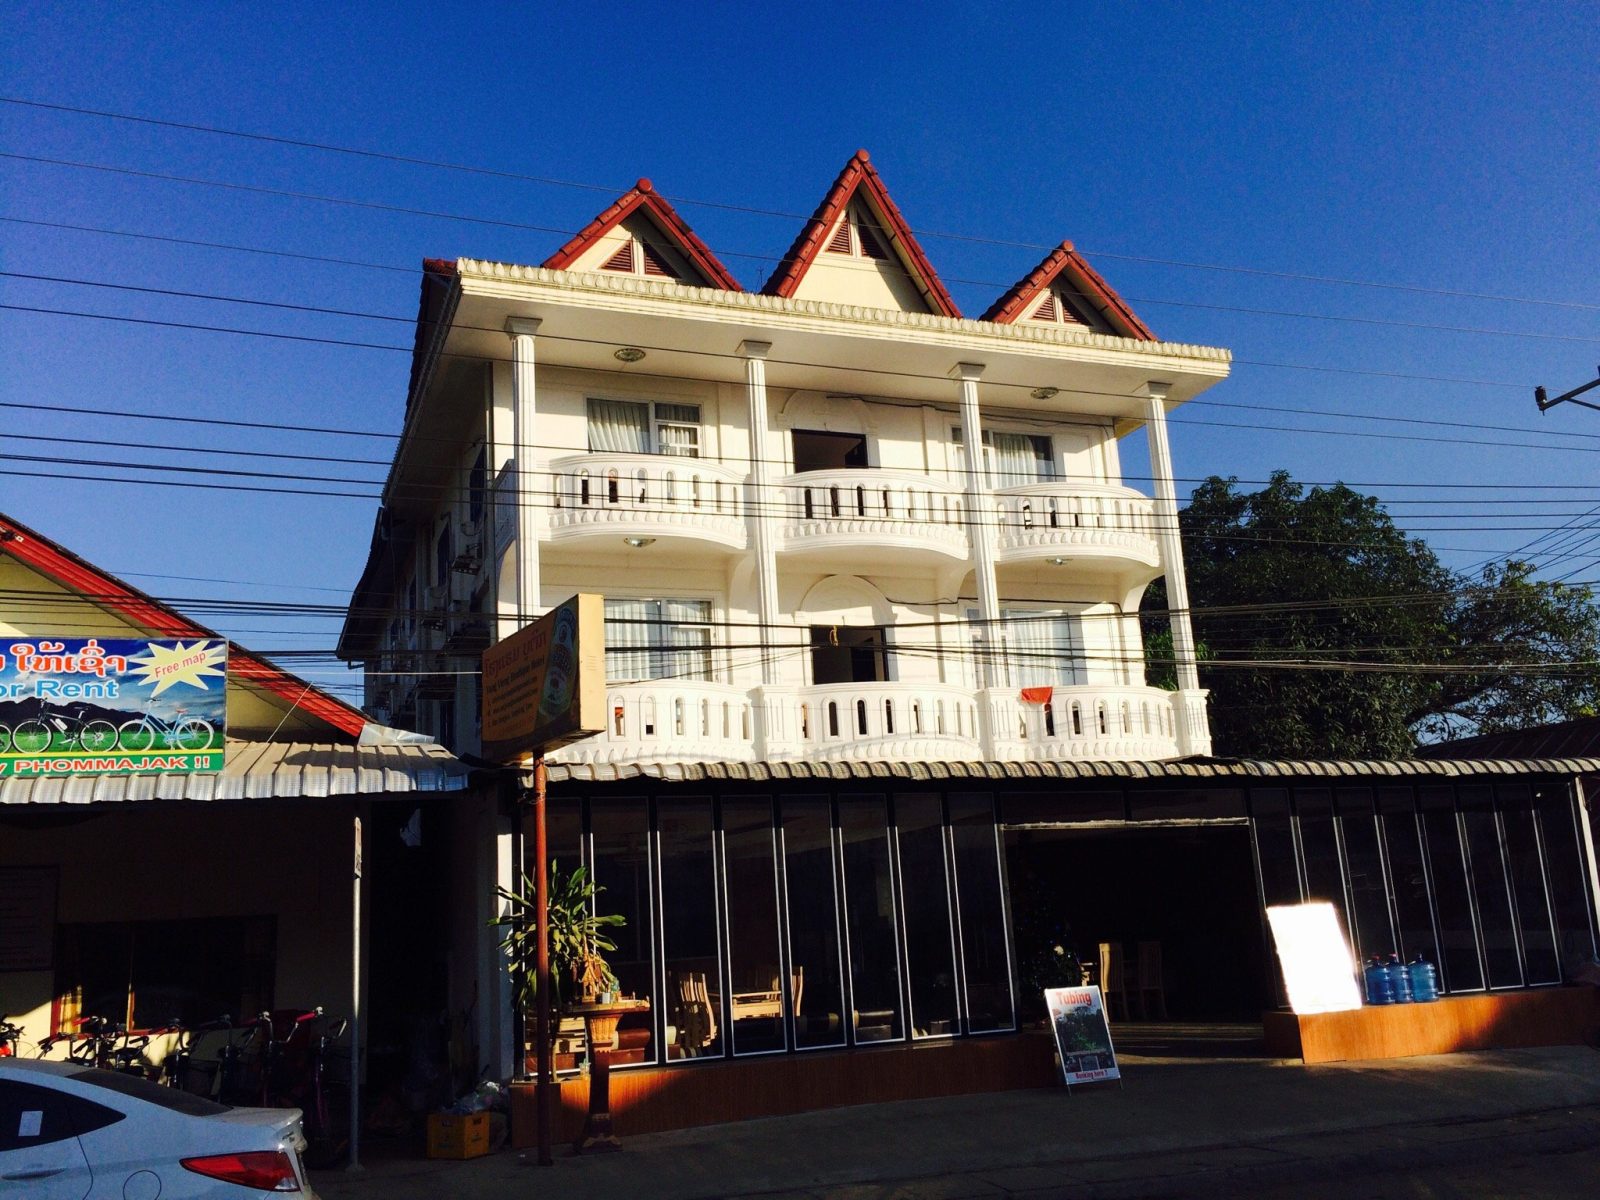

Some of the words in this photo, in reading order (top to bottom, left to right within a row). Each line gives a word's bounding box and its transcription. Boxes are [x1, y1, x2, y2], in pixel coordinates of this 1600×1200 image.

[154, 662, 179, 678] Free
[182, 652, 207, 668] map
[36, 680, 118, 698] Rent
[15, 756, 187, 772] PHOMMAJAK
[1056, 991, 1092, 1007] Tubing
